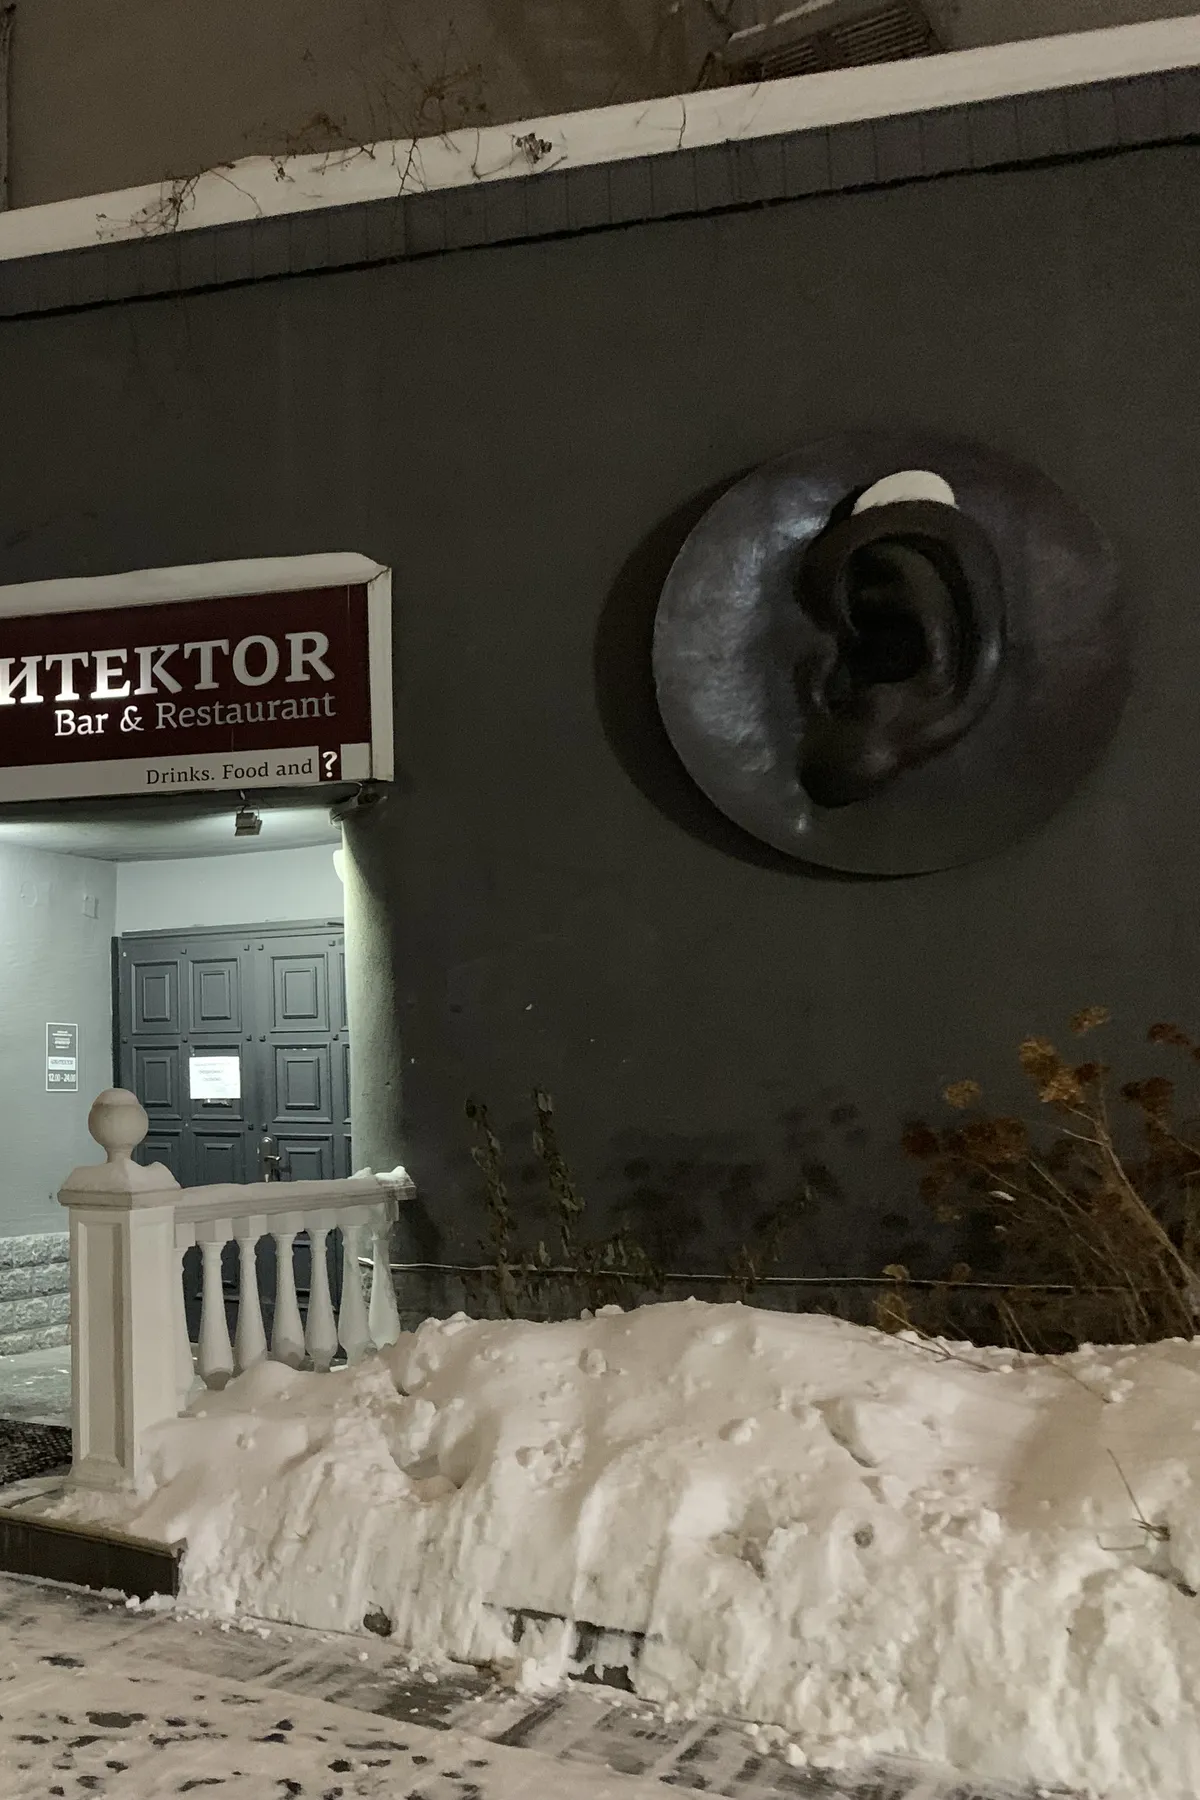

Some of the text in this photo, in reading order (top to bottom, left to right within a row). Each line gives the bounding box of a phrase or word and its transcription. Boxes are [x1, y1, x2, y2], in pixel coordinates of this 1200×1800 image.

[54, 692, 336, 737] Bar & Restaurant
[146, 751, 338, 785] Drinks. Food and ?
